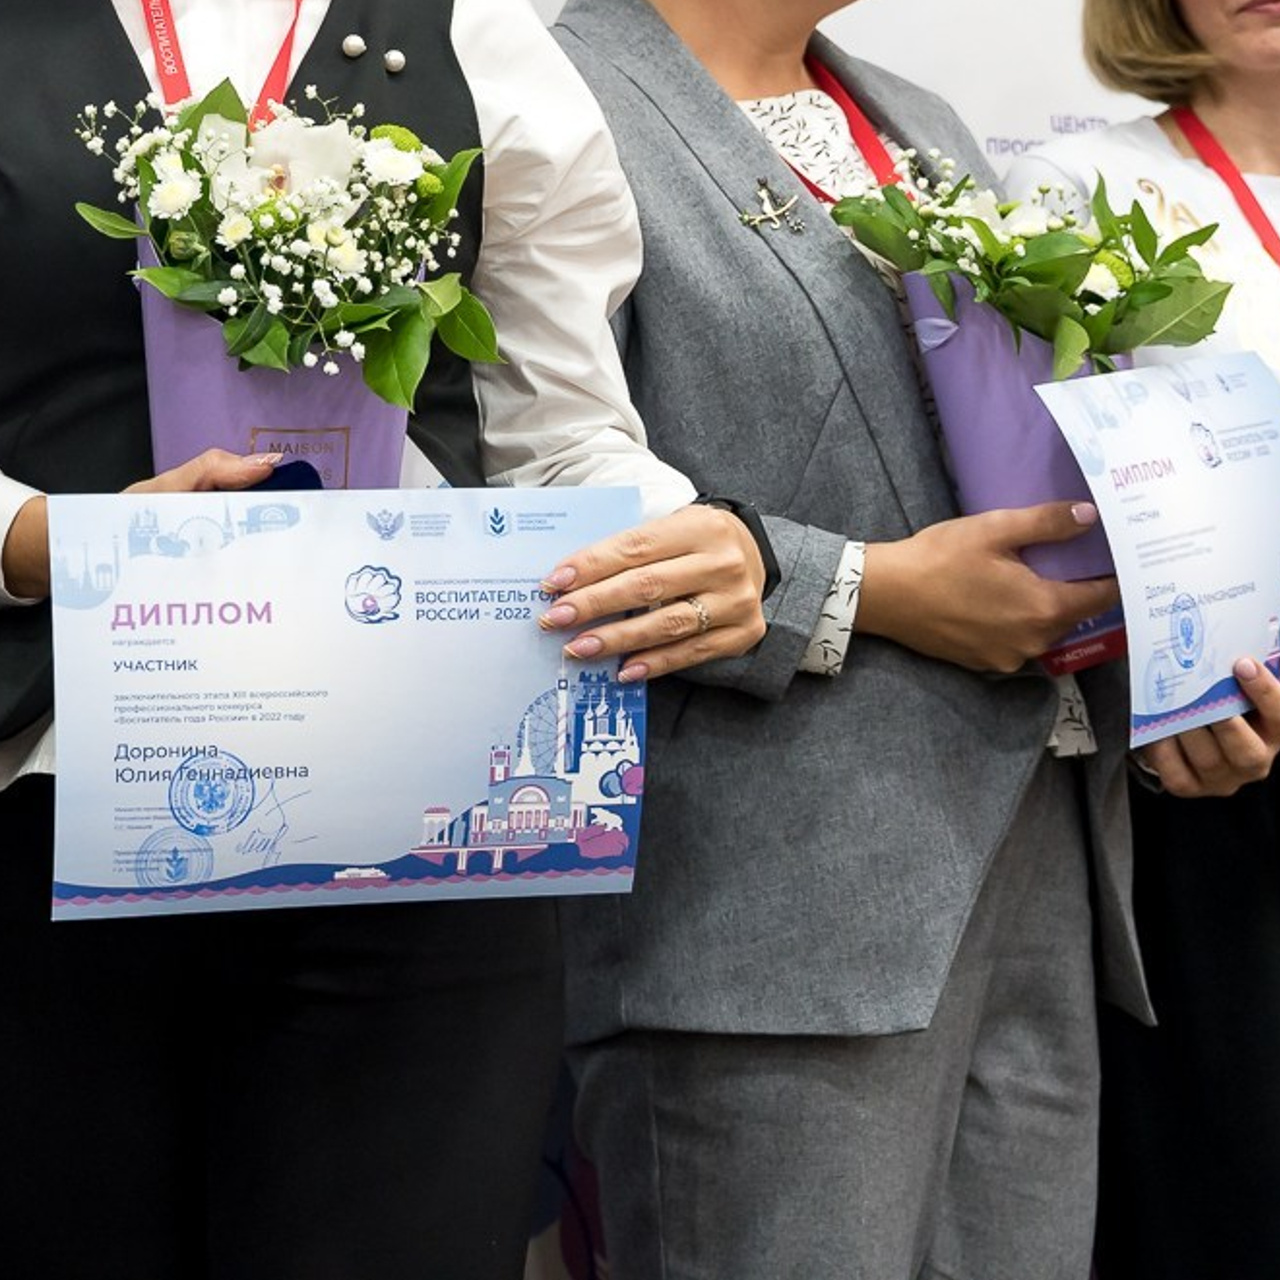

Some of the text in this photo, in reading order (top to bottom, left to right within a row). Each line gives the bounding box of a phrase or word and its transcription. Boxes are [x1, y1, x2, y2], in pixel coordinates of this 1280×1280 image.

[268, 441, 335, 455] MAISON
[1109, 458, 1176, 491] ДИПЛОМ
[415, 589, 528, 605] ВОСПИТАТЕЛЬ
[111, 601, 273, 631] ДИПЛОМ
[415, 607, 480, 621] РОССИИ
[494, 607, 532, 621] 2022
[113, 659, 199, 673] УЧАСТНИК
[259, 712, 282, 722] 2022
[113, 743, 219, 763] Доронина
[114, 764, 310, 784] Юлия Геннадиевна
